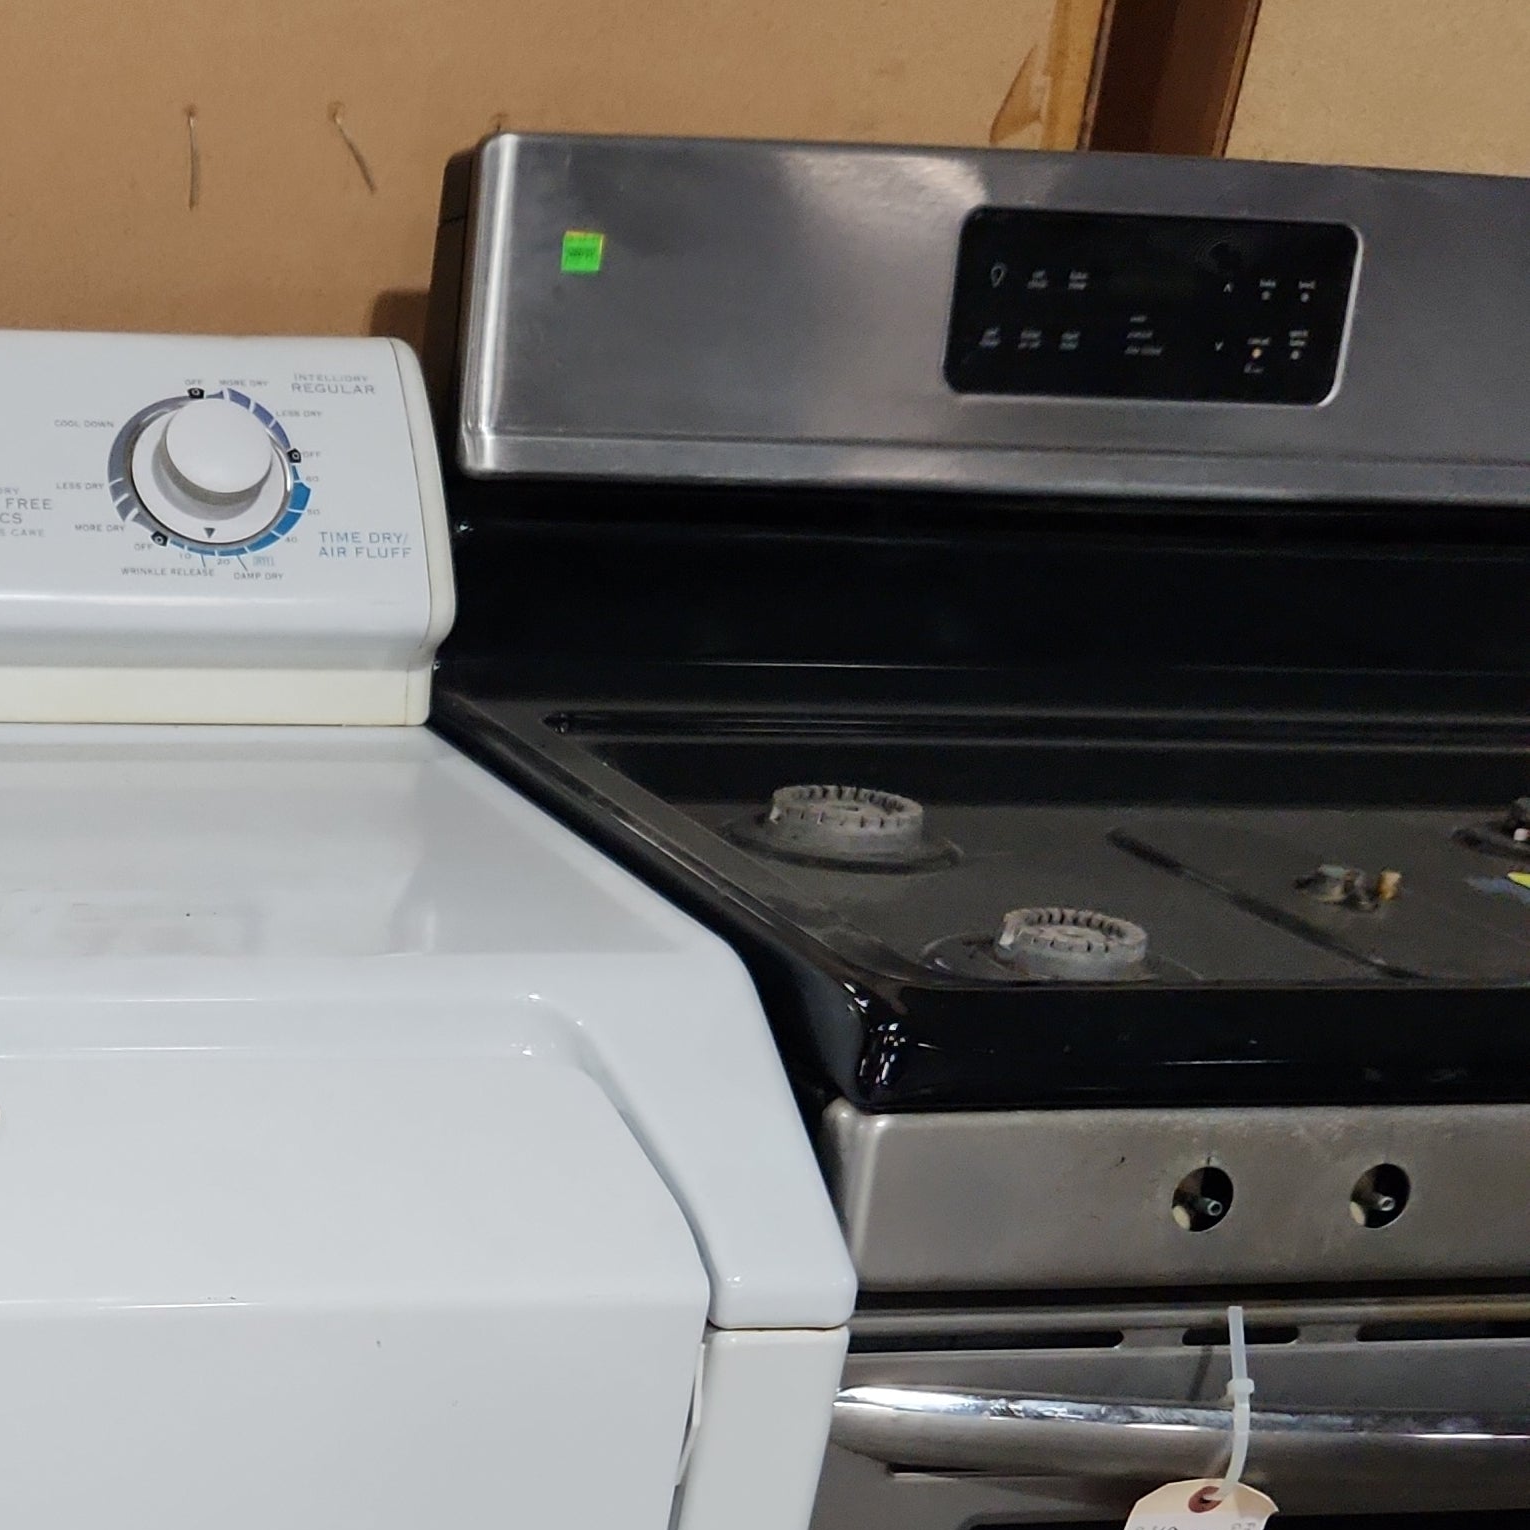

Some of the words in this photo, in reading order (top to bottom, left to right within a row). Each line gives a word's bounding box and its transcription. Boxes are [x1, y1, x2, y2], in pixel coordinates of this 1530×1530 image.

[291, 383, 375, 394] REGULAR
[6, 498, 53, 510] FREE
[11, 528, 46, 538] CARE
[319, 531, 362, 544] TIME
[318, 546, 347, 558] AIR
[355, 547, 412, 559] FLUFF
[121, 567, 166, 576] WRINKLE
